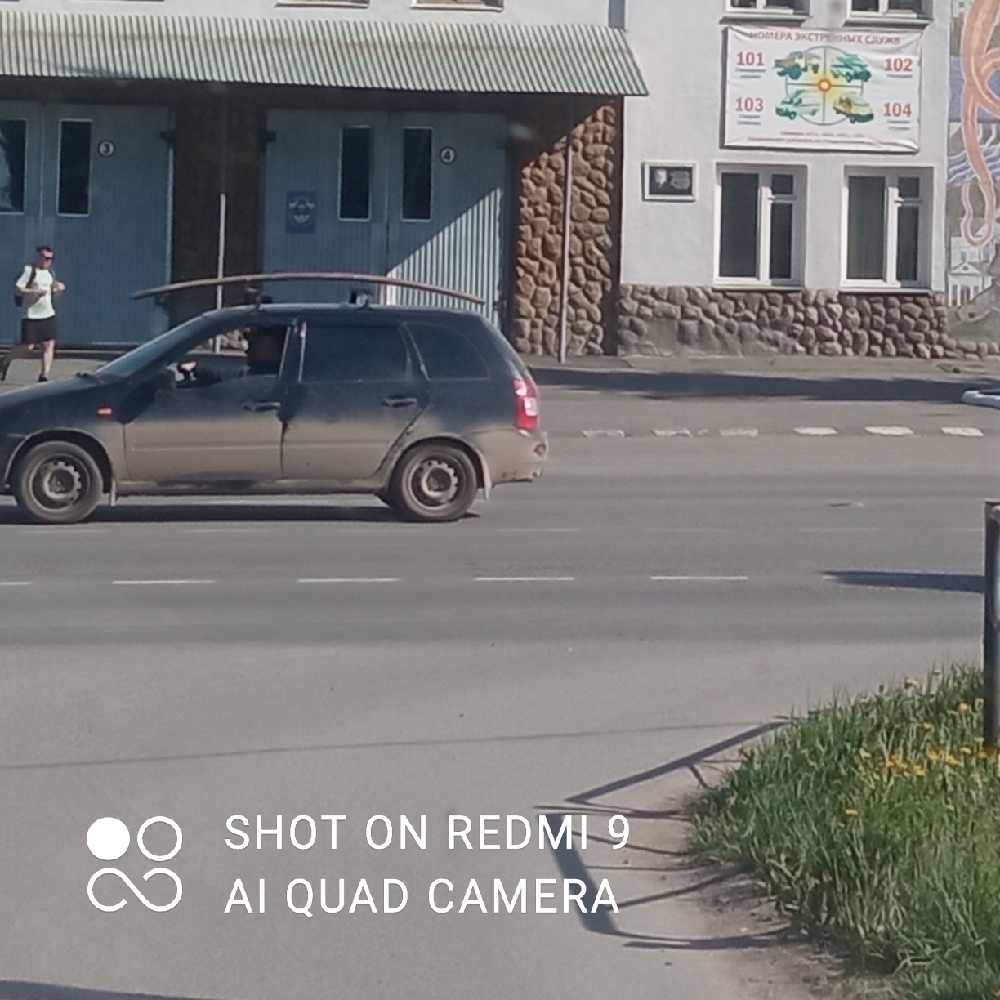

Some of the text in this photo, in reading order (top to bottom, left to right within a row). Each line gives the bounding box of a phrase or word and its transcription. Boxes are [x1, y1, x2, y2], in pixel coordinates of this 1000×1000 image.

[750, 31, 793, 42] НОМЕРА
[736, 51, 765, 67] 101
[884, 58, 914, 73] 102
[735, 97, 764, 112] 103
[883, 102, 912, 118] 104
